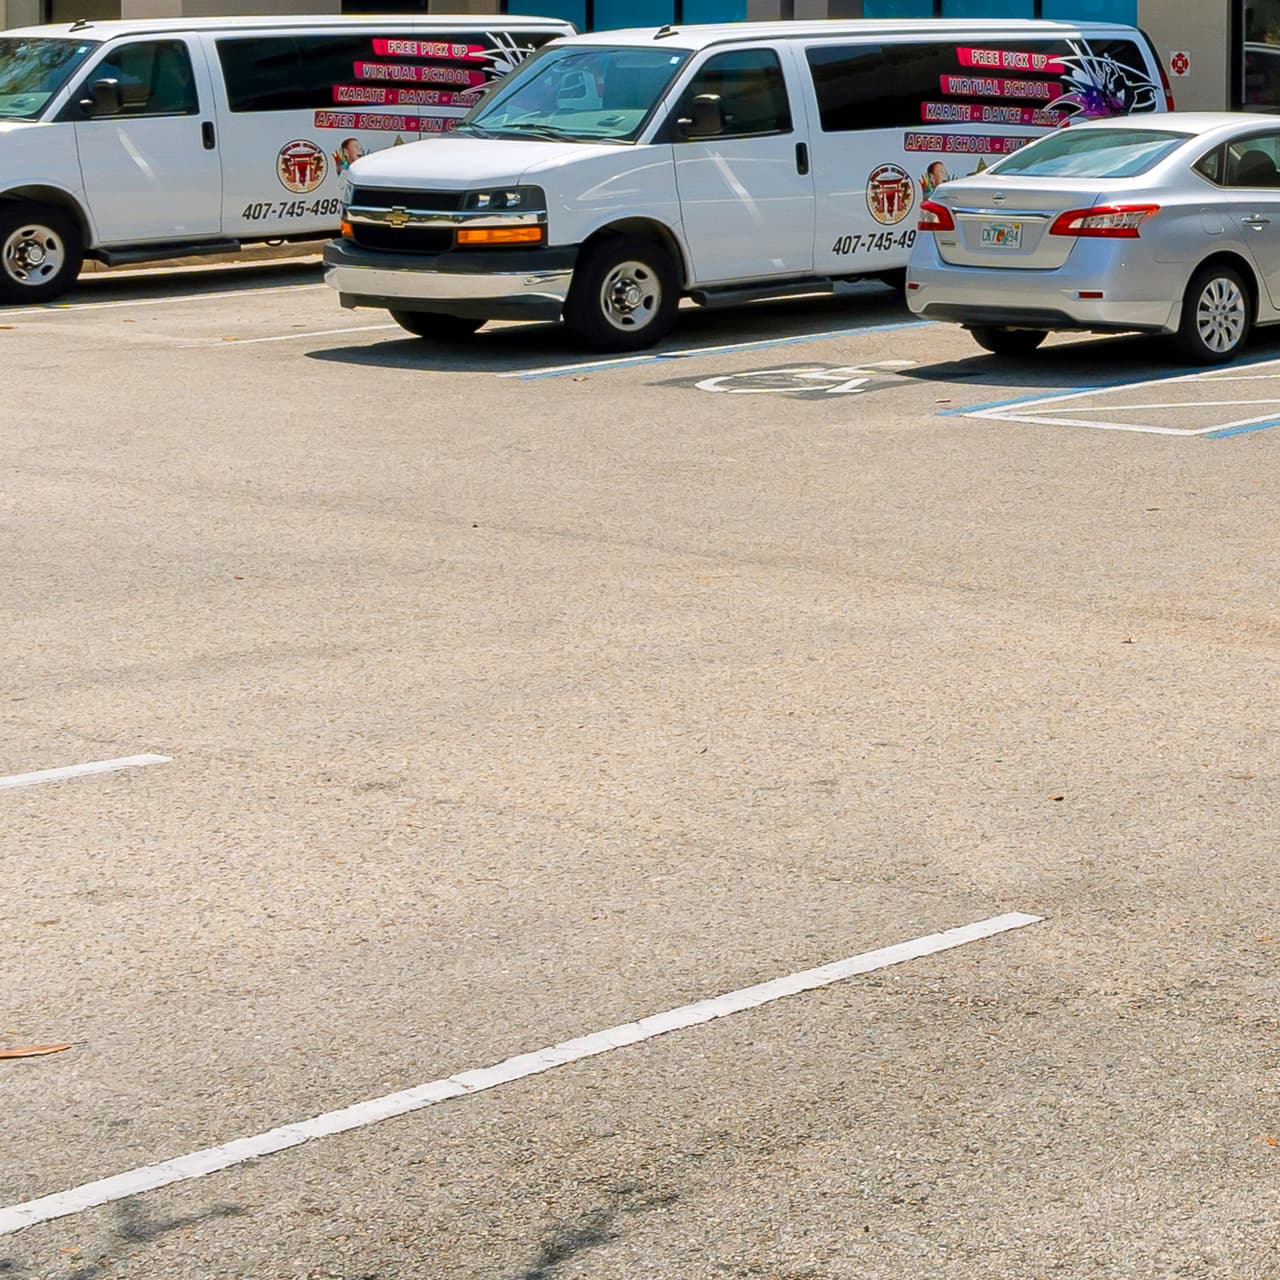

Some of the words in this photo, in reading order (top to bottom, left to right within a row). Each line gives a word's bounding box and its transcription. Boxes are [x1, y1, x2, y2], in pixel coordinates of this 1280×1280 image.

[388, 40, 417, 54] FREE
[420, 42, 447, 56] PICK
[451, 43, 469, 57] UP
[971, 49, 999, 65] FREE
[1003, 53, 1029, 67] PICK
[1032, 55, 1048, 69] UP
[362, 64, 417, 81] VIRTUAL
[421, 68, 471, 85] SCHOOL
[337, 86, 386, 103] KARATE
[398, 89, 439, 105] DANCE
[450, 91, 480, 107] ARTS
[948, 77, 1000, 96] VIRTUAL
[1004, 81, 1050, 98] SCHOOL
[315, 112, 355, 128] AFTER
[358, 115, 408, 131] SCHOOL
[419, 117, 443, 132] FUN
[926, 103, 971, 121] KARATE
[982, 106, 1021, 124] DANCE
[1032, 109, 1060, 125] ARTS
[905, 133, 943, 151] AFTER
[945, 135, 992, 153] SCHOOL
[832, 229, 916, 255] 407-745-49
